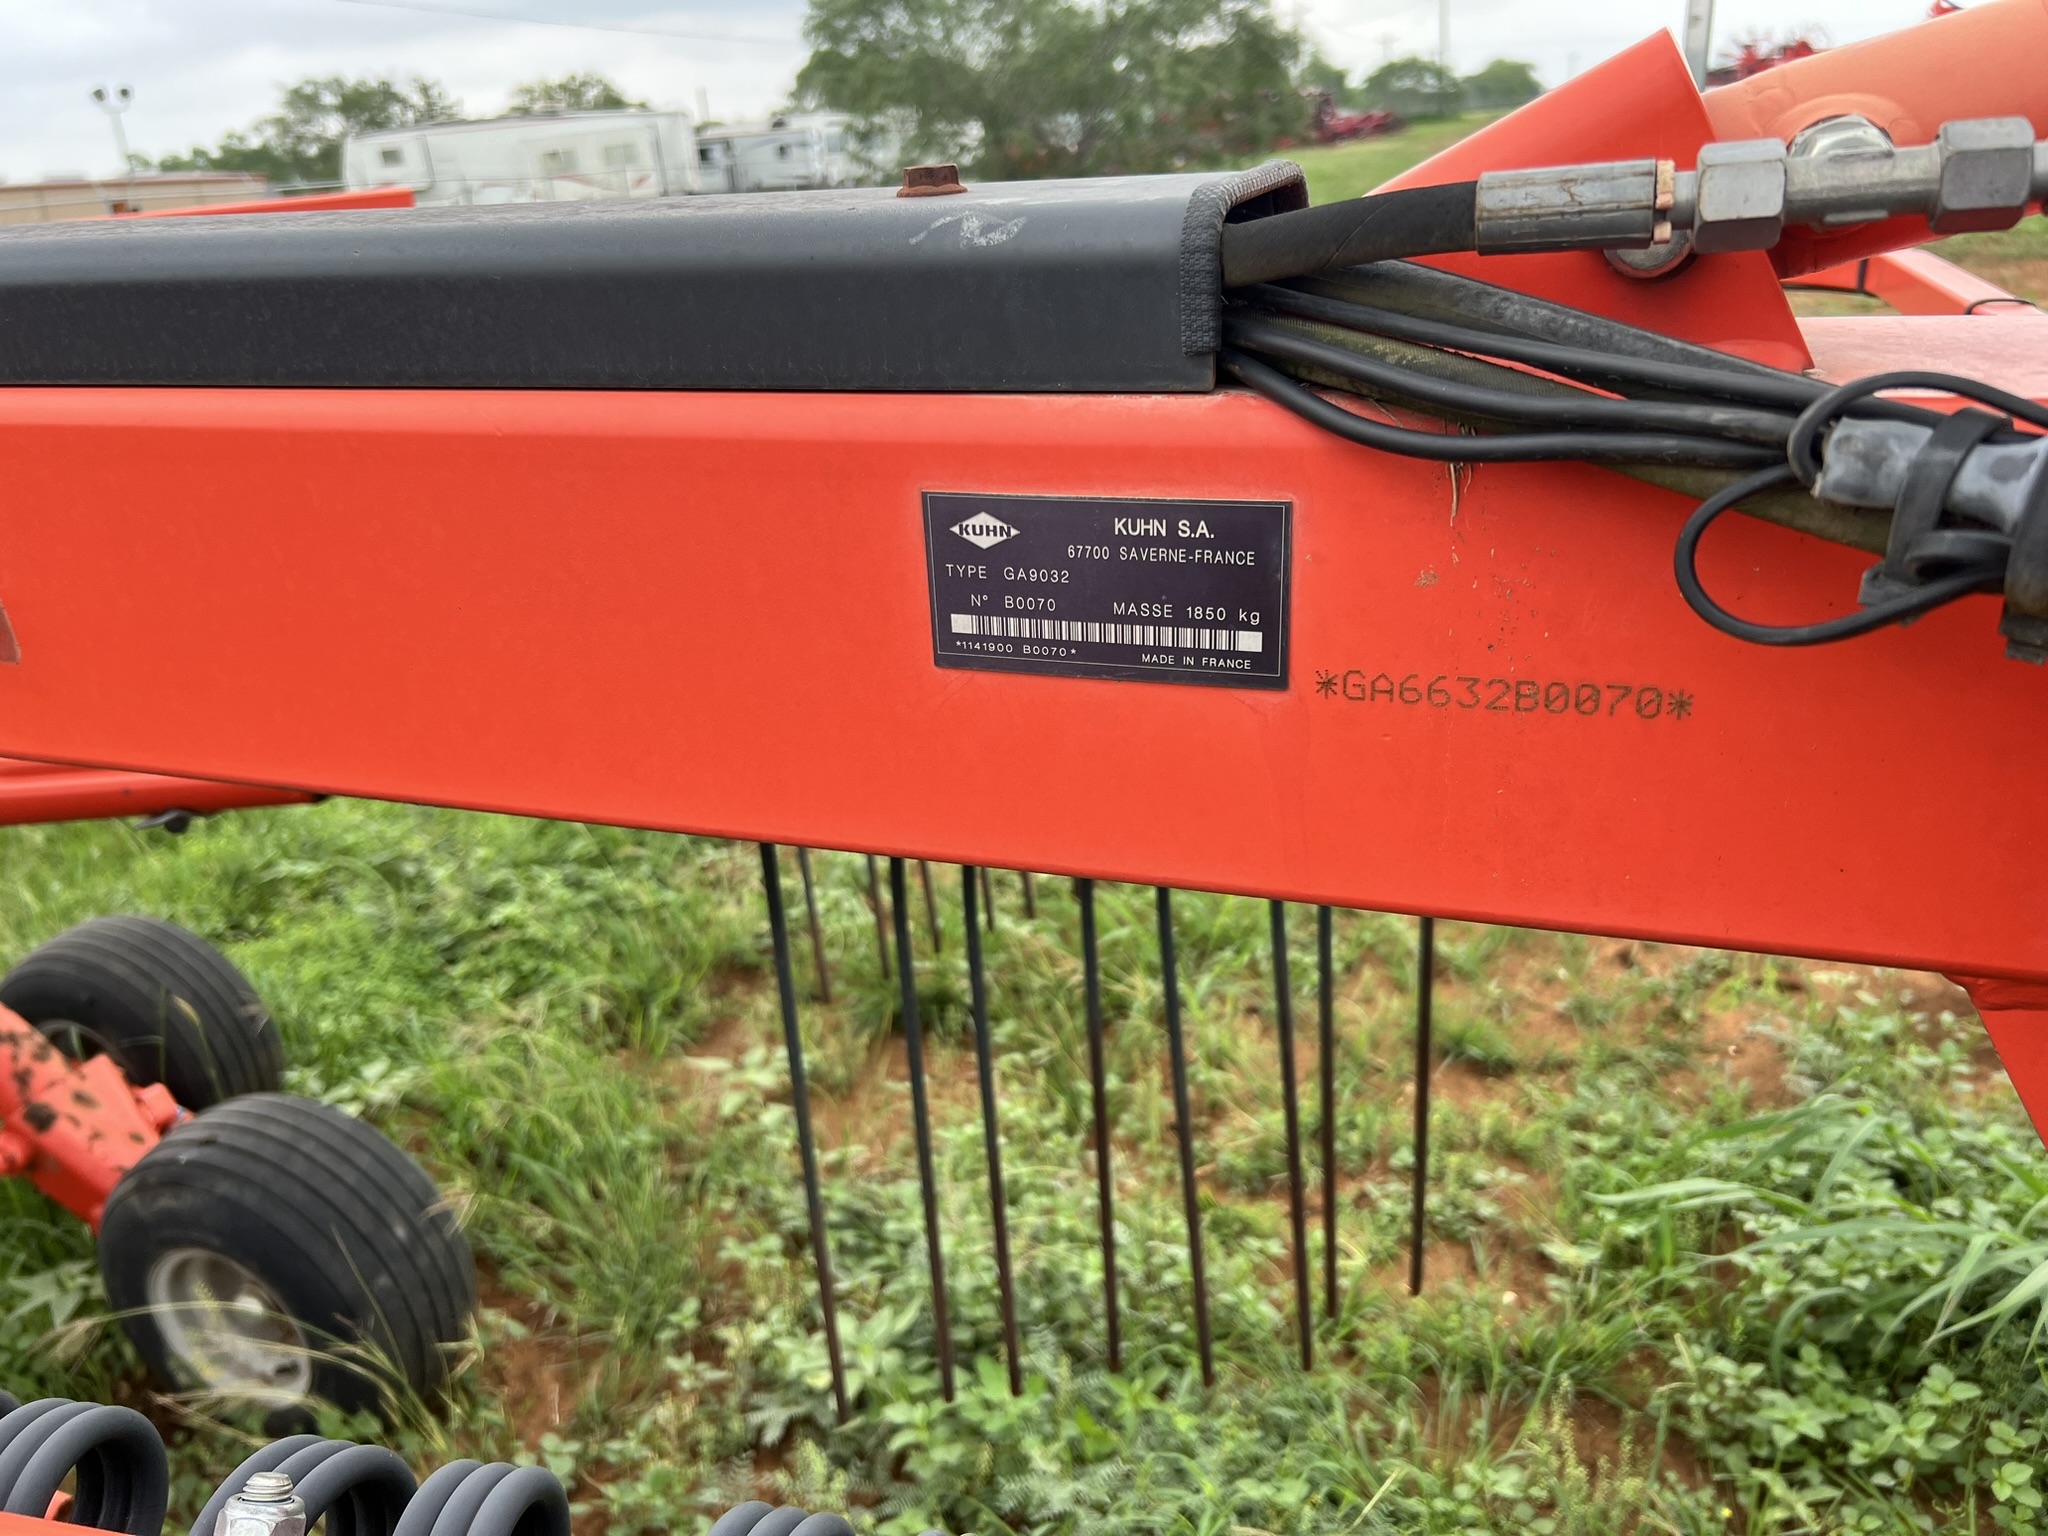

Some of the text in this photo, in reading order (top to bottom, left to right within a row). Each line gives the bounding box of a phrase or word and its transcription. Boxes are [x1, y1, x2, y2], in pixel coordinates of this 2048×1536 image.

[958, 522, 1012, 539] KUHN
[1114, 518, 1215, 539] KUHN S.A.
[1067, 545, 1255, 566] 67700 SAVERNE-FRANCE
[946, 564, 1070, 584] TYPE GA9032
[1004, 596, 1056, 611] B0070
[1113, 602, 1260, 625] MASSE 1850 kg
[1142, 654, 1251, 670] MADE IN FRANCE
